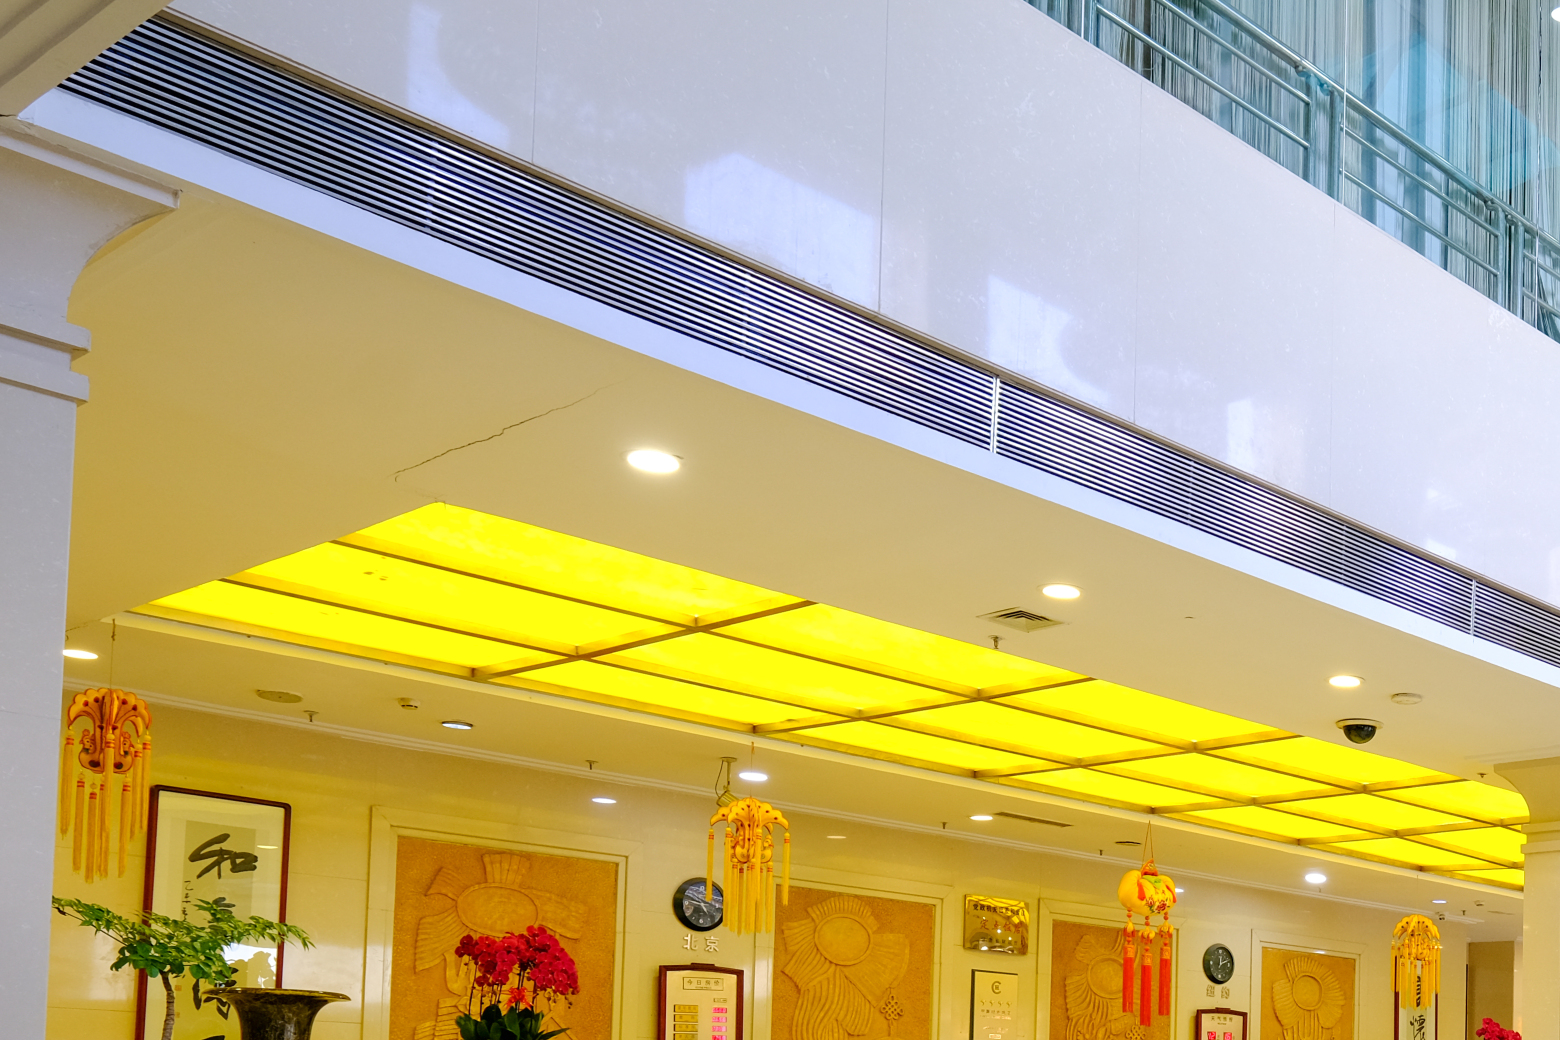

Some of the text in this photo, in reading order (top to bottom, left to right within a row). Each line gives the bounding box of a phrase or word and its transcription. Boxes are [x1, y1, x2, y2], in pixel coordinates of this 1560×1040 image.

[683, 933, 719, 952] 北京
[687, 979, 720, 987] 今日房价
[1206, 984, 1230, 999] 纽约
